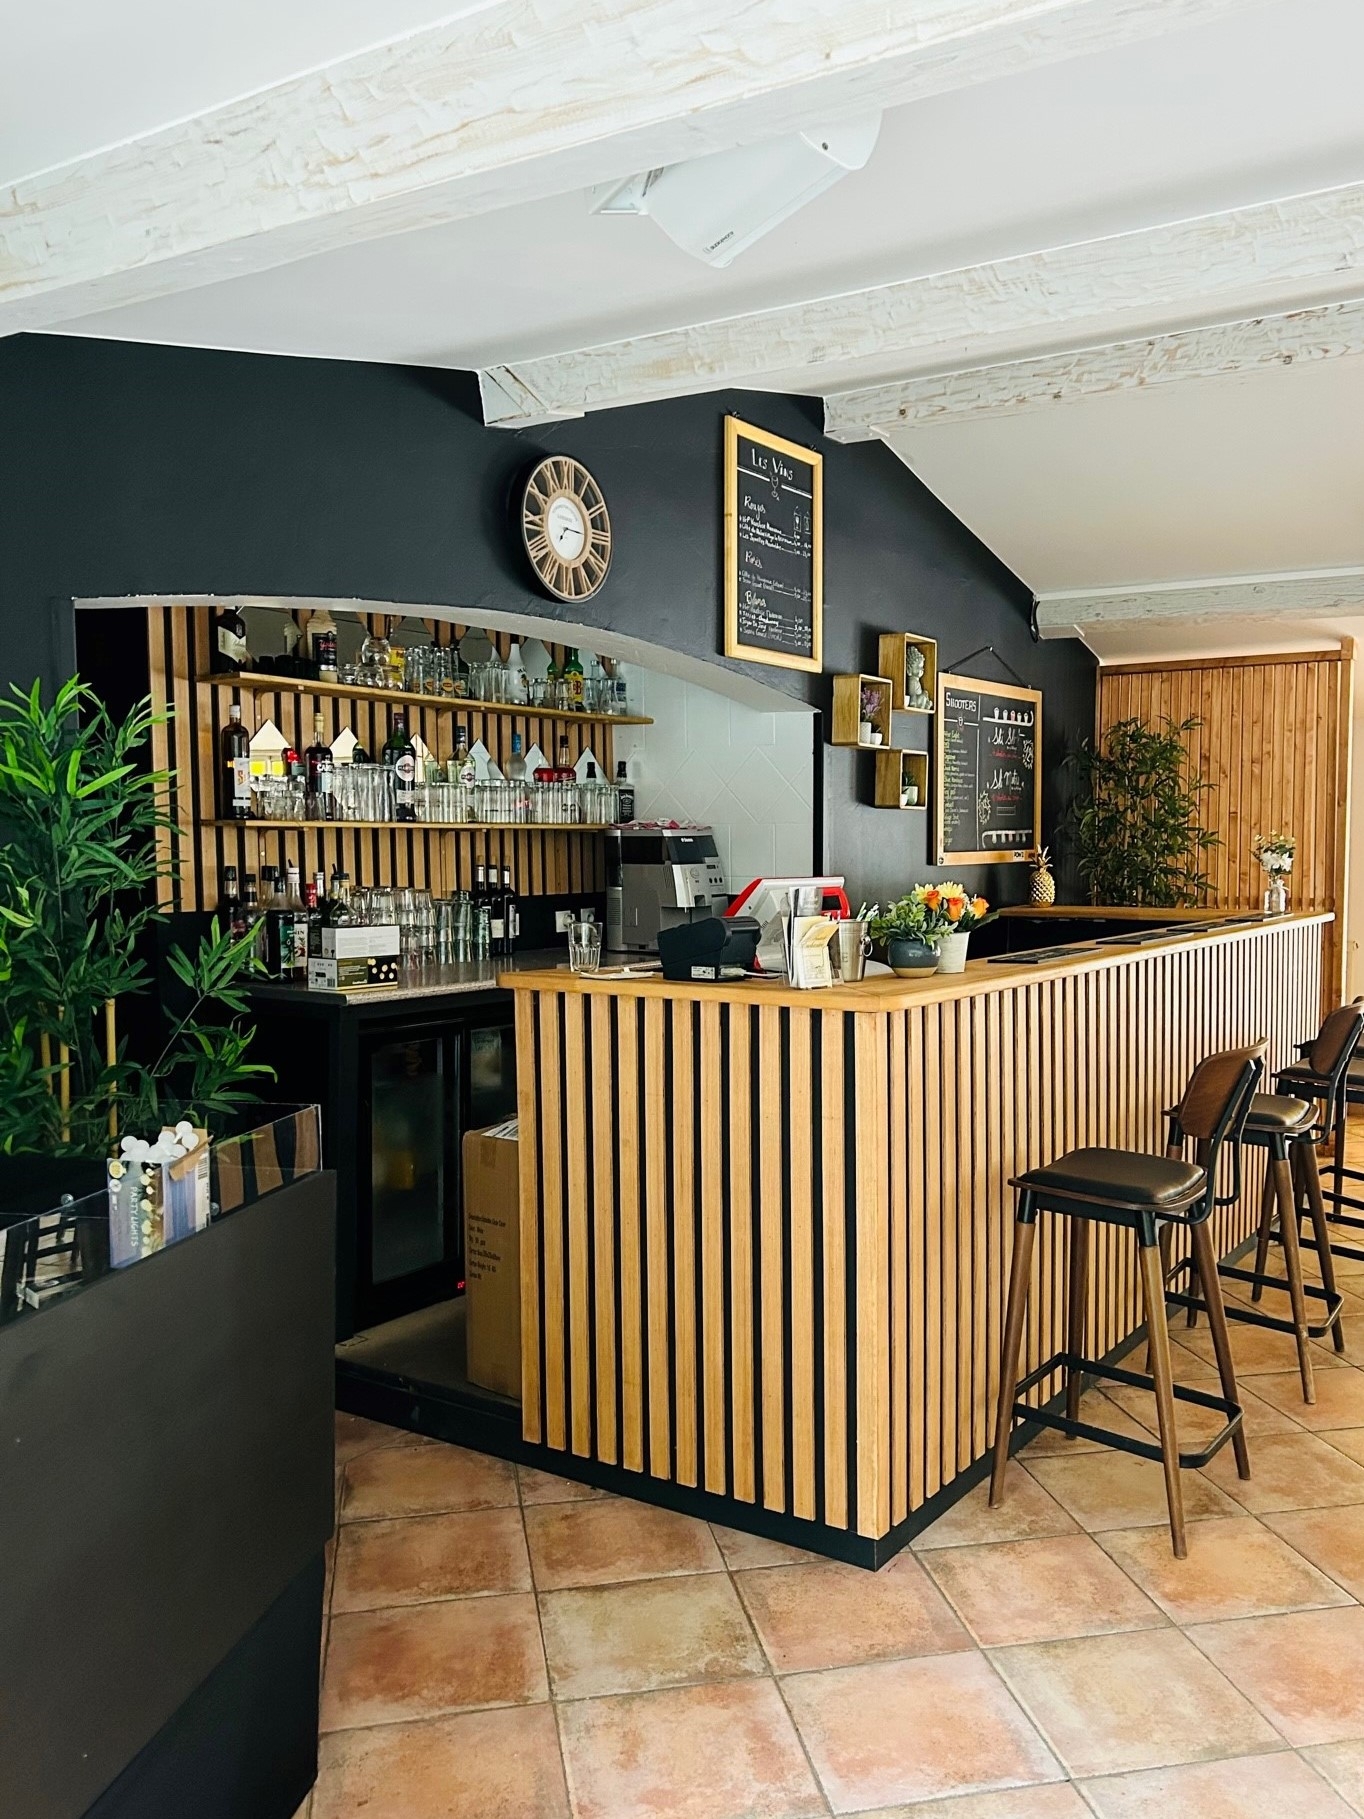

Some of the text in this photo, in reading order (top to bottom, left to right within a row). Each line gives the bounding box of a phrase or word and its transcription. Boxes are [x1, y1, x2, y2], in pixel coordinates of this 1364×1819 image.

[773, 457, 793, 481] Vins
[130, 1186, 139, 1247] PARTY LIGHTS
